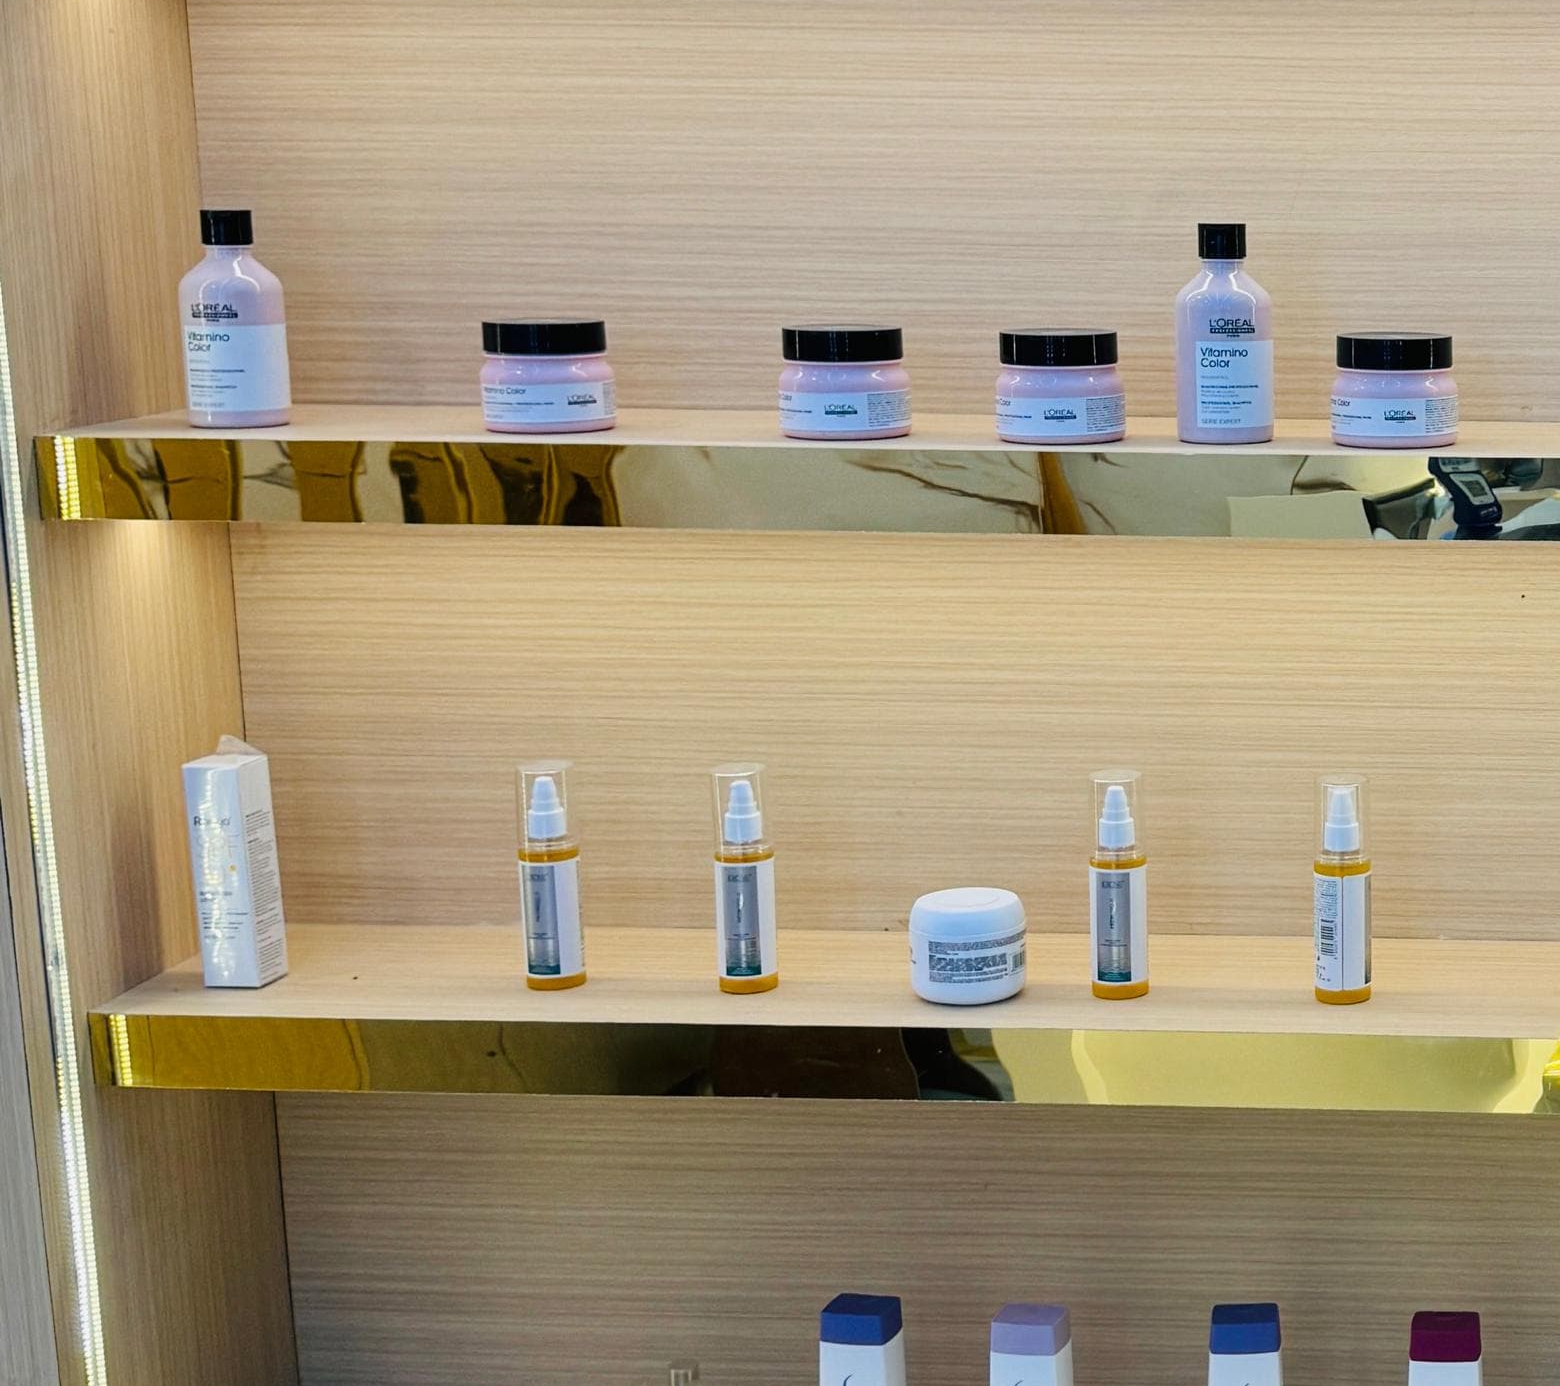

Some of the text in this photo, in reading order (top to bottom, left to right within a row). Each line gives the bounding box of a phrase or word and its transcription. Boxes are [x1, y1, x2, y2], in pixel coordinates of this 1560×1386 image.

[187, 331, 230, 342] Vitamino
[187, 341, 211, 352] Color
[1200, 347, 1249, 358] Vitamino
[1200, 357, 1231, 368] Color
[506, 386, 527, 395] Color
